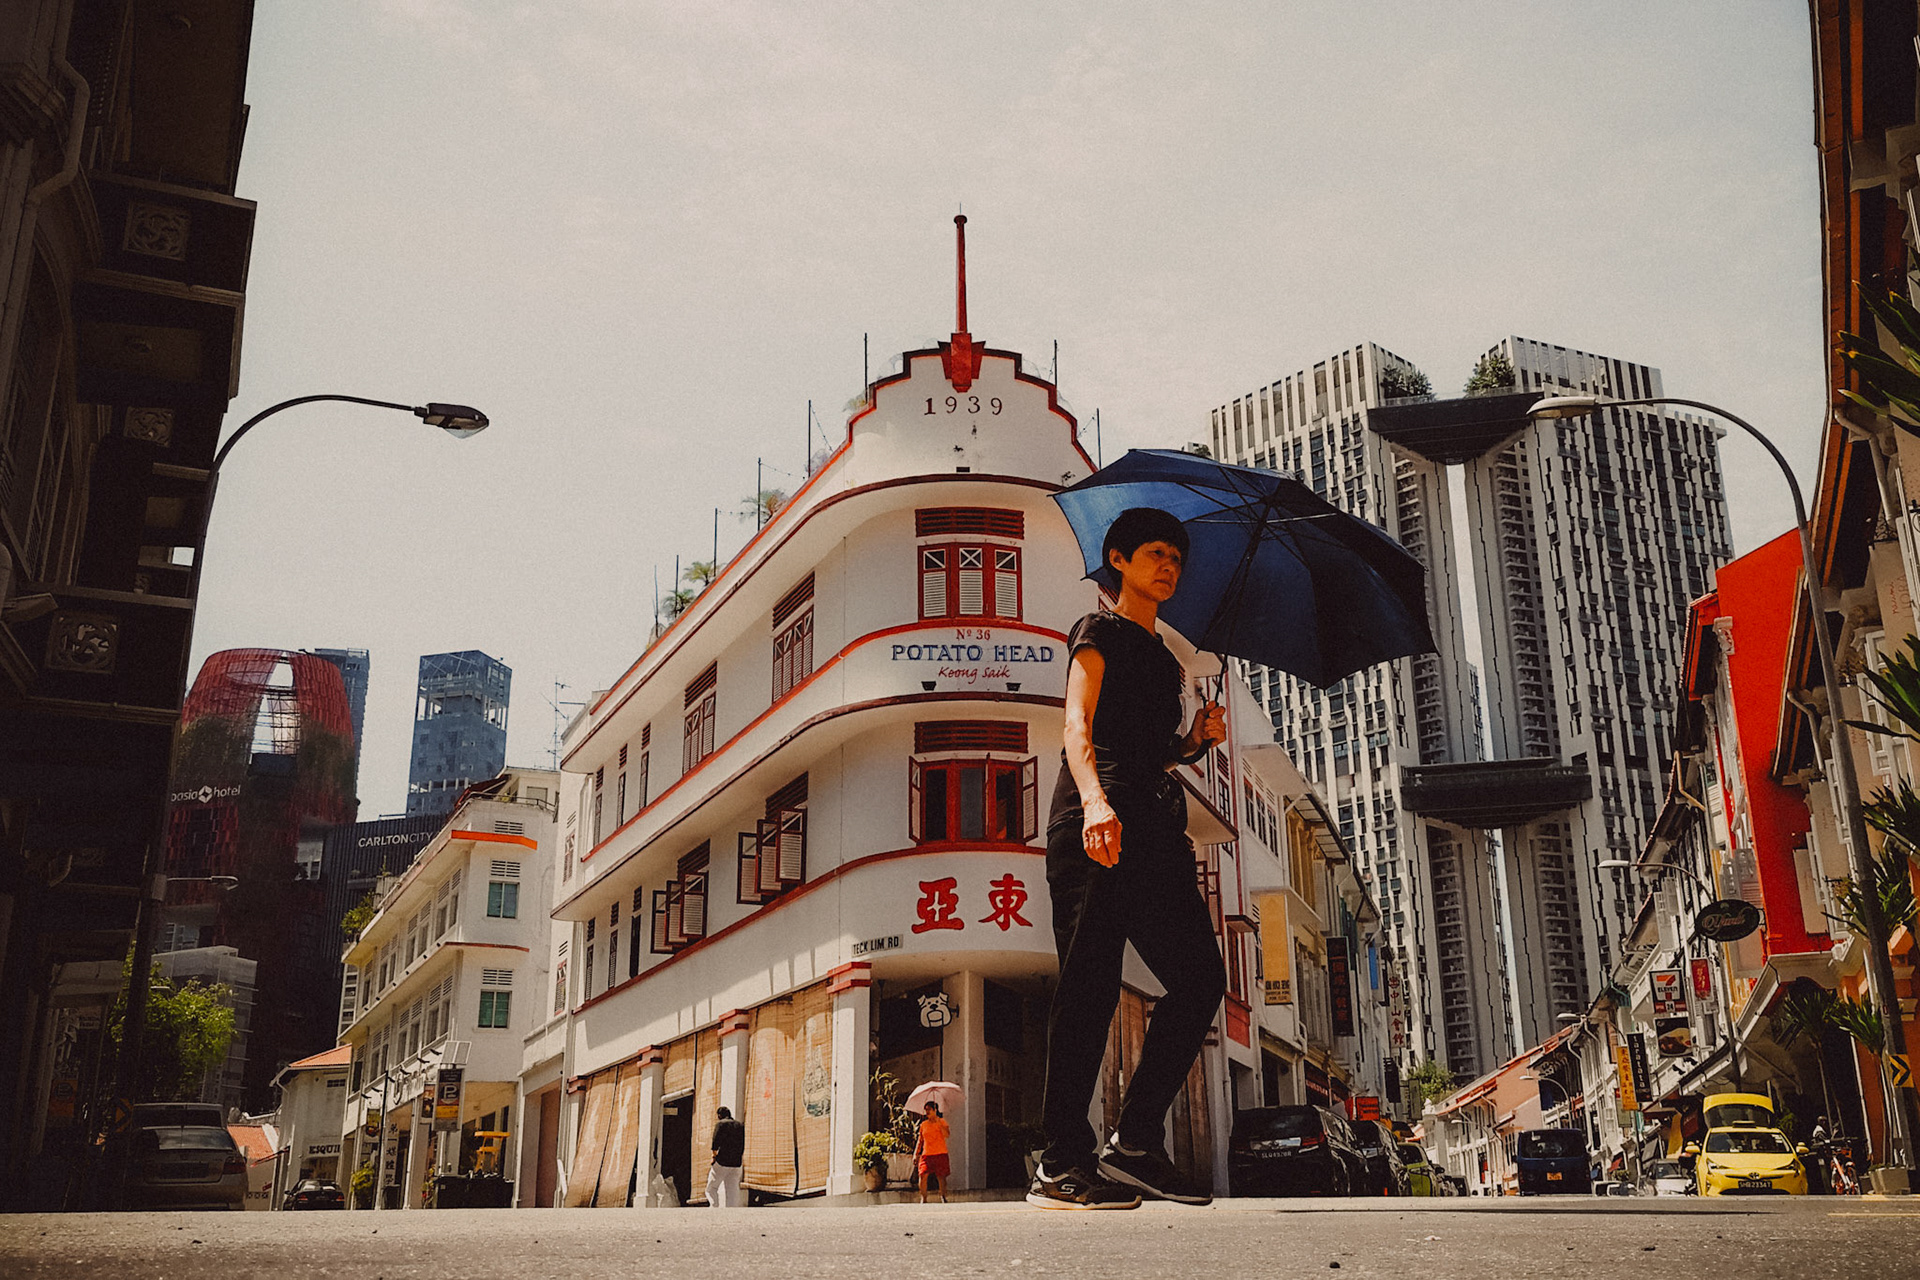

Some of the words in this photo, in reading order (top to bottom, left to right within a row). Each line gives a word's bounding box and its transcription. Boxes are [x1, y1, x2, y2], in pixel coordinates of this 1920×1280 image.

[923, 395, 1003, 416] 1939
[976, 629, 991, 641] 36
[891, 644, 983, 662] POTATO
[995, 645, 1055, 663] HEAD
[938, 666, 978, 685] Keong
[982, 664, 1011, 679] Saik
[213, 784, 241, 798] hotel
[853, 940, 868, 955] TECK
[870, 937, 885, 951] LIM
[887, 935, 899, 949] RD
